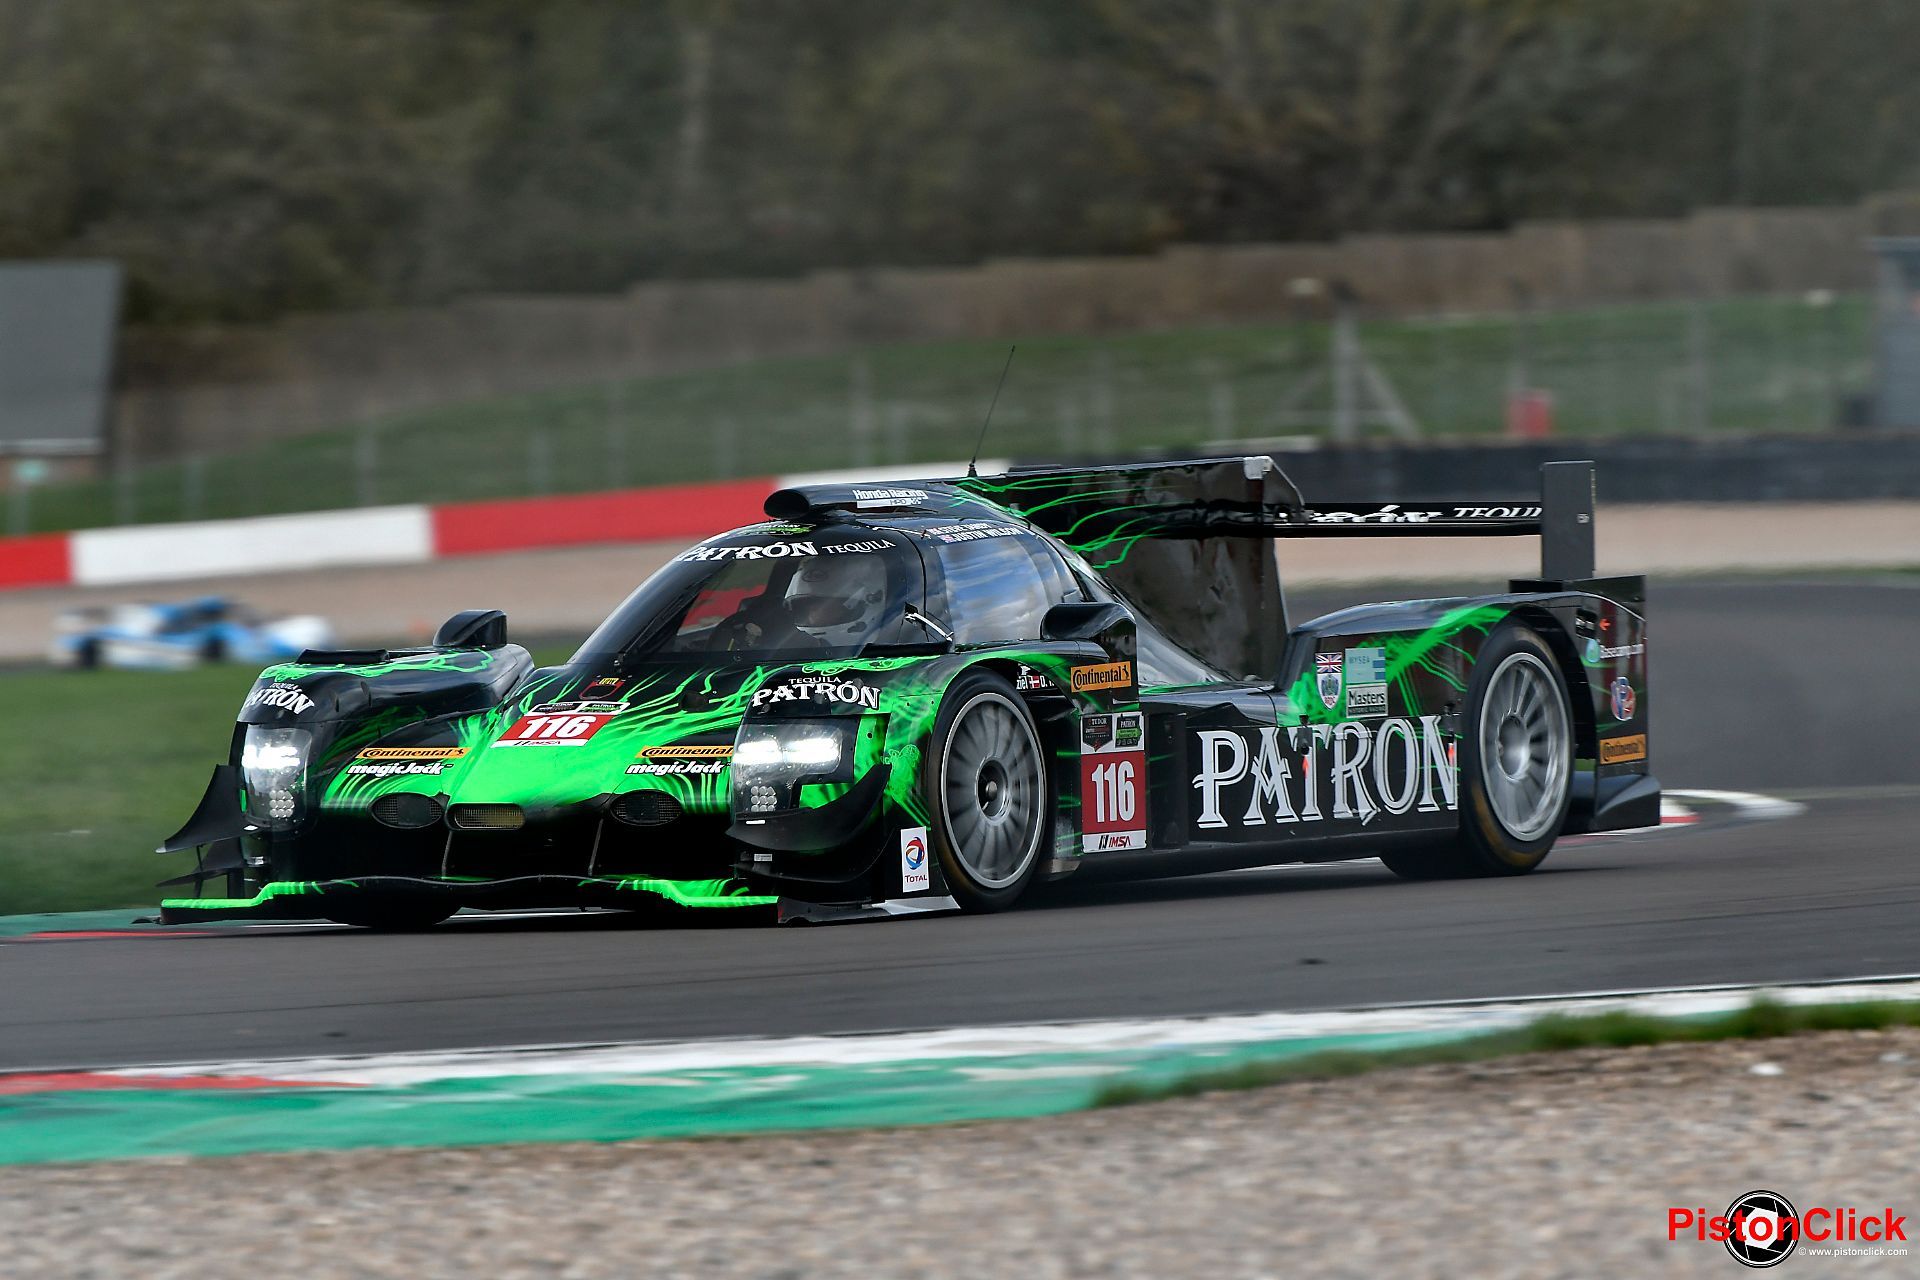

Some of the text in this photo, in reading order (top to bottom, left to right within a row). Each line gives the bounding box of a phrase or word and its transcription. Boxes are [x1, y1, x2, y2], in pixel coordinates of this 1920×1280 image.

[852, 489, 929, 500] Honda Racing
[952, 527, 1025, 541] JUSTIN WILSON
[822, 539, 896, 555] TEQUILA
[788, 676, 841, 684] TEQUILA
[1073, 665, 1121, 690] Continental
[752, 681, 880, 710] PATRÓN
[1348, 690, 1385, 706] Masters
[518, 715, 597, 739] 116
[363, 748, 453, 757] Continental
[641, 747, 733, 757] Continental
[347, 762, 444, 778] magicJack
[626, 761, 724, 776] magicJack
[1092, 760, 1135, 823] 116
[1109, 836, 1132, 848] IMSA
[904, 874, 927, 883] TOTAL
